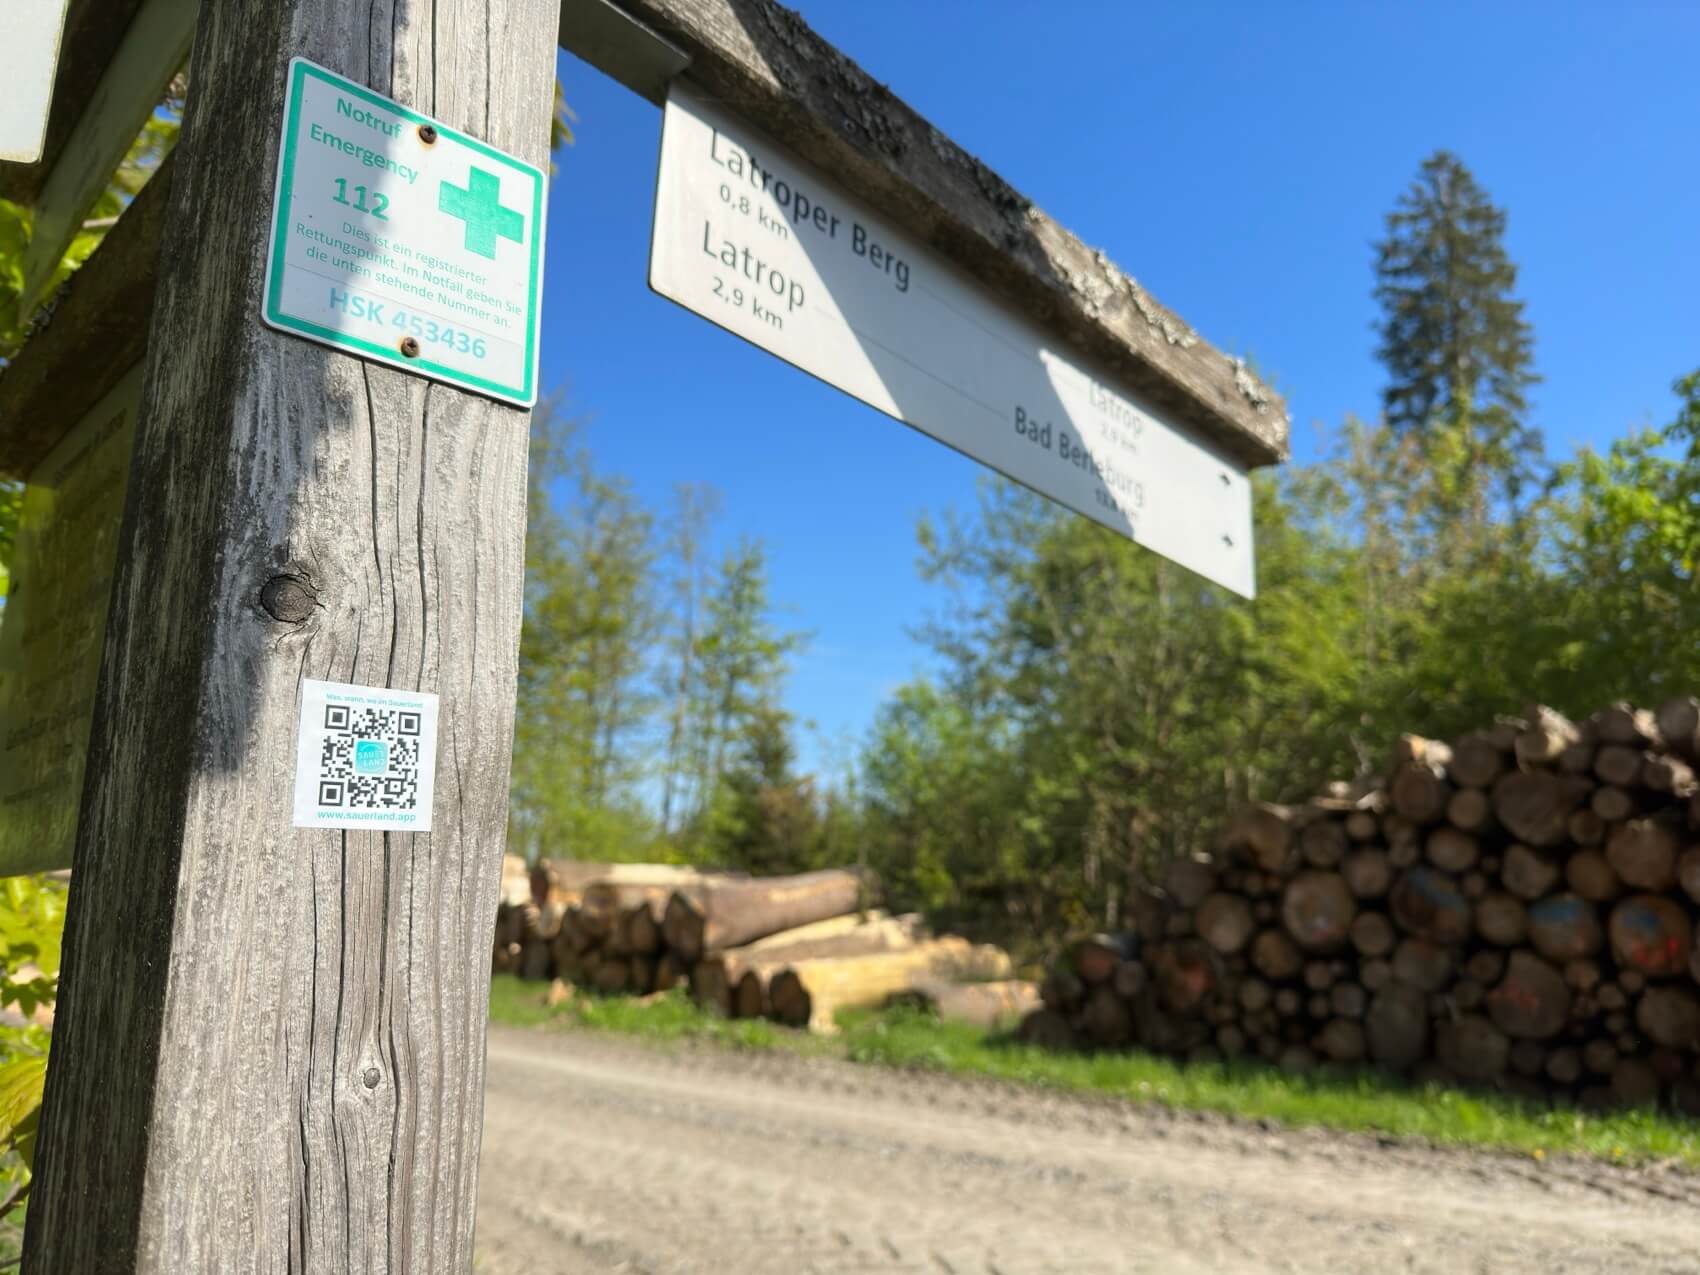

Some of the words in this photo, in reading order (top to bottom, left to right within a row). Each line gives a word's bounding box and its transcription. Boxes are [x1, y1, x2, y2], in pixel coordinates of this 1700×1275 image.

[336, 98, 402, 140] Notruf
[310, 123, 418, 184] Emergency
[332, 177, 390, 221] 112
[711, 128, 840, 238] Latroper
[853, 223, 910, 293] Berg
[719, 184, 750, 215] 0,8
[759, 206, 788, 240] km
[296, 223, 399, 270] Rettungspunkt.
[403, 263, 418, 278] Im
[423, 270, 463, 293] Notfall
[466, 288, 502, 309] geben
[505, 301, 522, 316] Sie
[343, 222, 370, 241] Dies
[374, 234, 389, 249] ist
[393, 243, 412, 257] ein
[416, 252, 487, 285] registrierter
[704, 220, 805, 312] Latrop
[306, 246, 328, 262] die
[332, 255, 371, 278] unten
[375, 272, 434, 300] stehende
[438, 293, 490, 320] Nummer
[494, 314, 511, 329] an.
[712, 276, 744, 307] 2,9
[753, 299, 783, 330] km
[329, 287, 383, 326] HSK
[391, 310, 487, 360] 453436
[1014, 406, 1051, 450] Bad
[317, 810, 416, 822] www.sauerland.app
